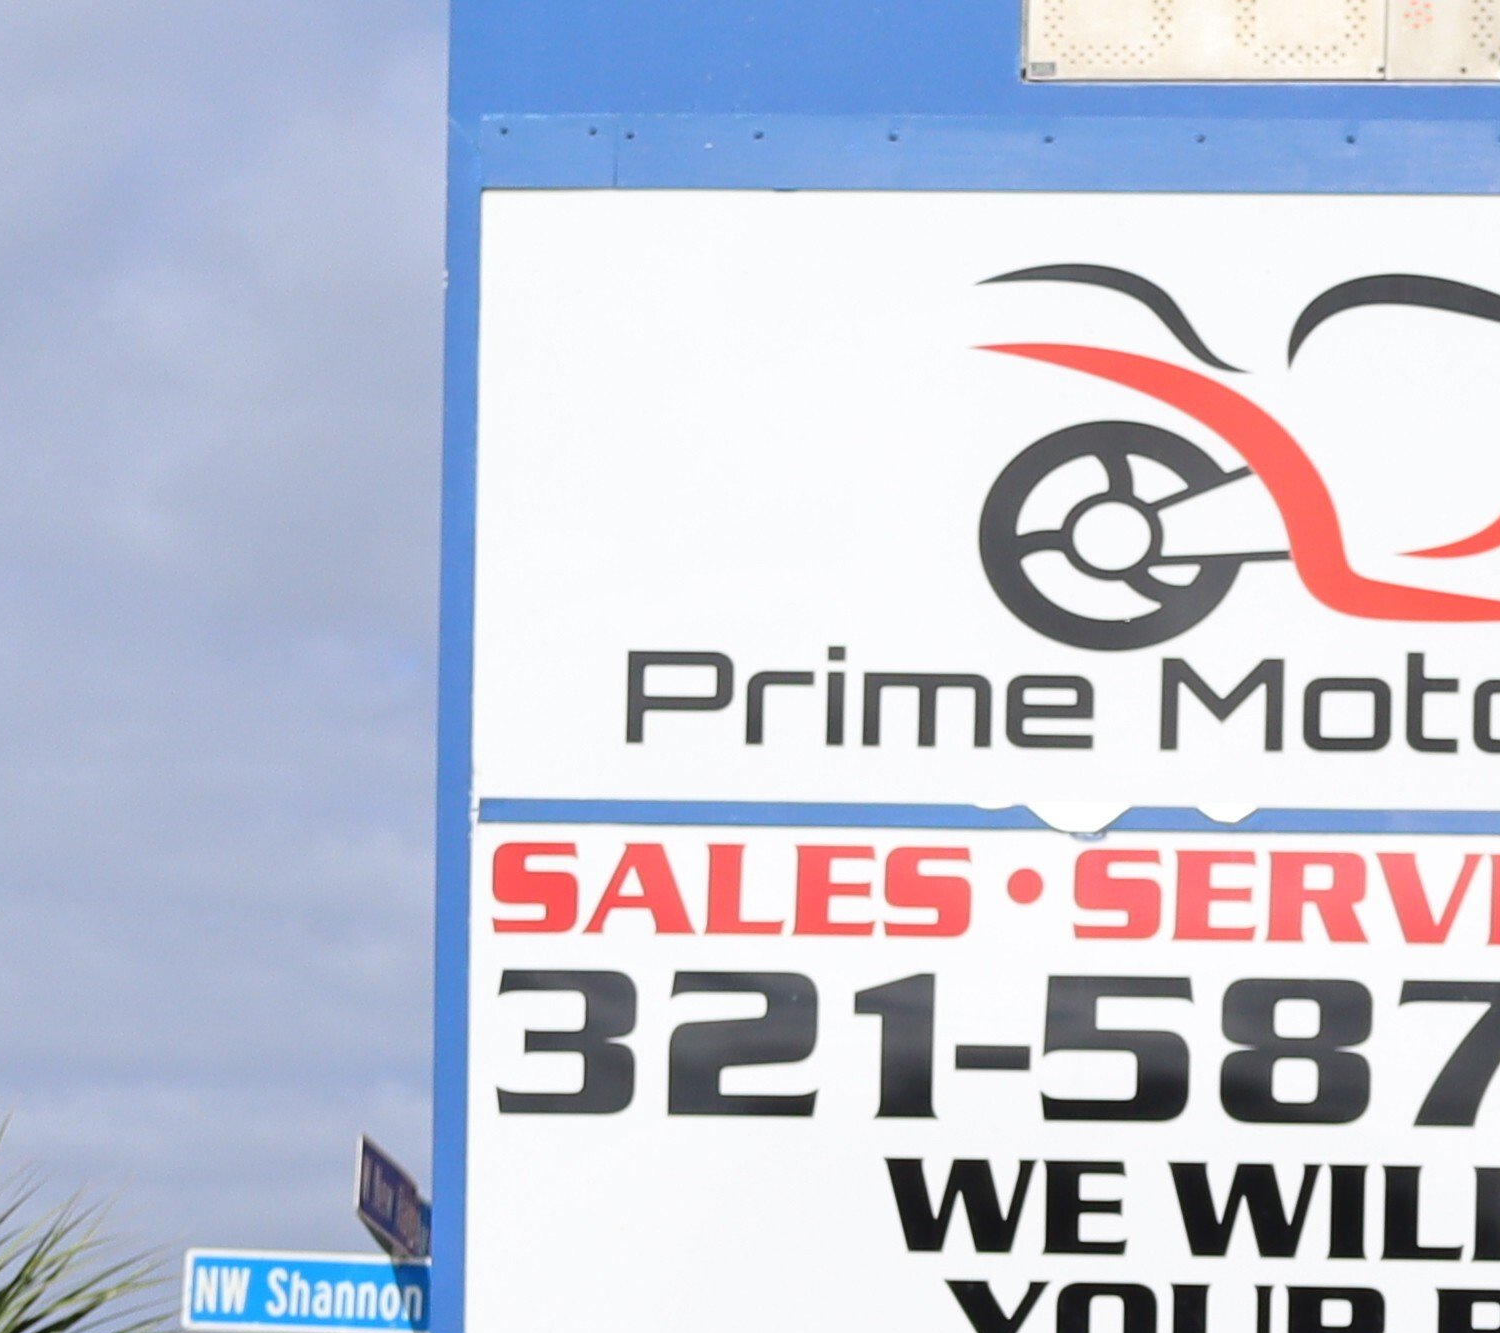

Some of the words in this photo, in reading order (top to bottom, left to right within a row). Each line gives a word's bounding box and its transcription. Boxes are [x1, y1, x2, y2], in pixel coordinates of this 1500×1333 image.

[625, 649, 1098, 749] Prime
[493, 842, 971, 937] SALES
[886, 1157, 1127, 1256] WE
[193, 1265, 251, 1314] NW
[266, 1267, 423, 1321] Shannon
